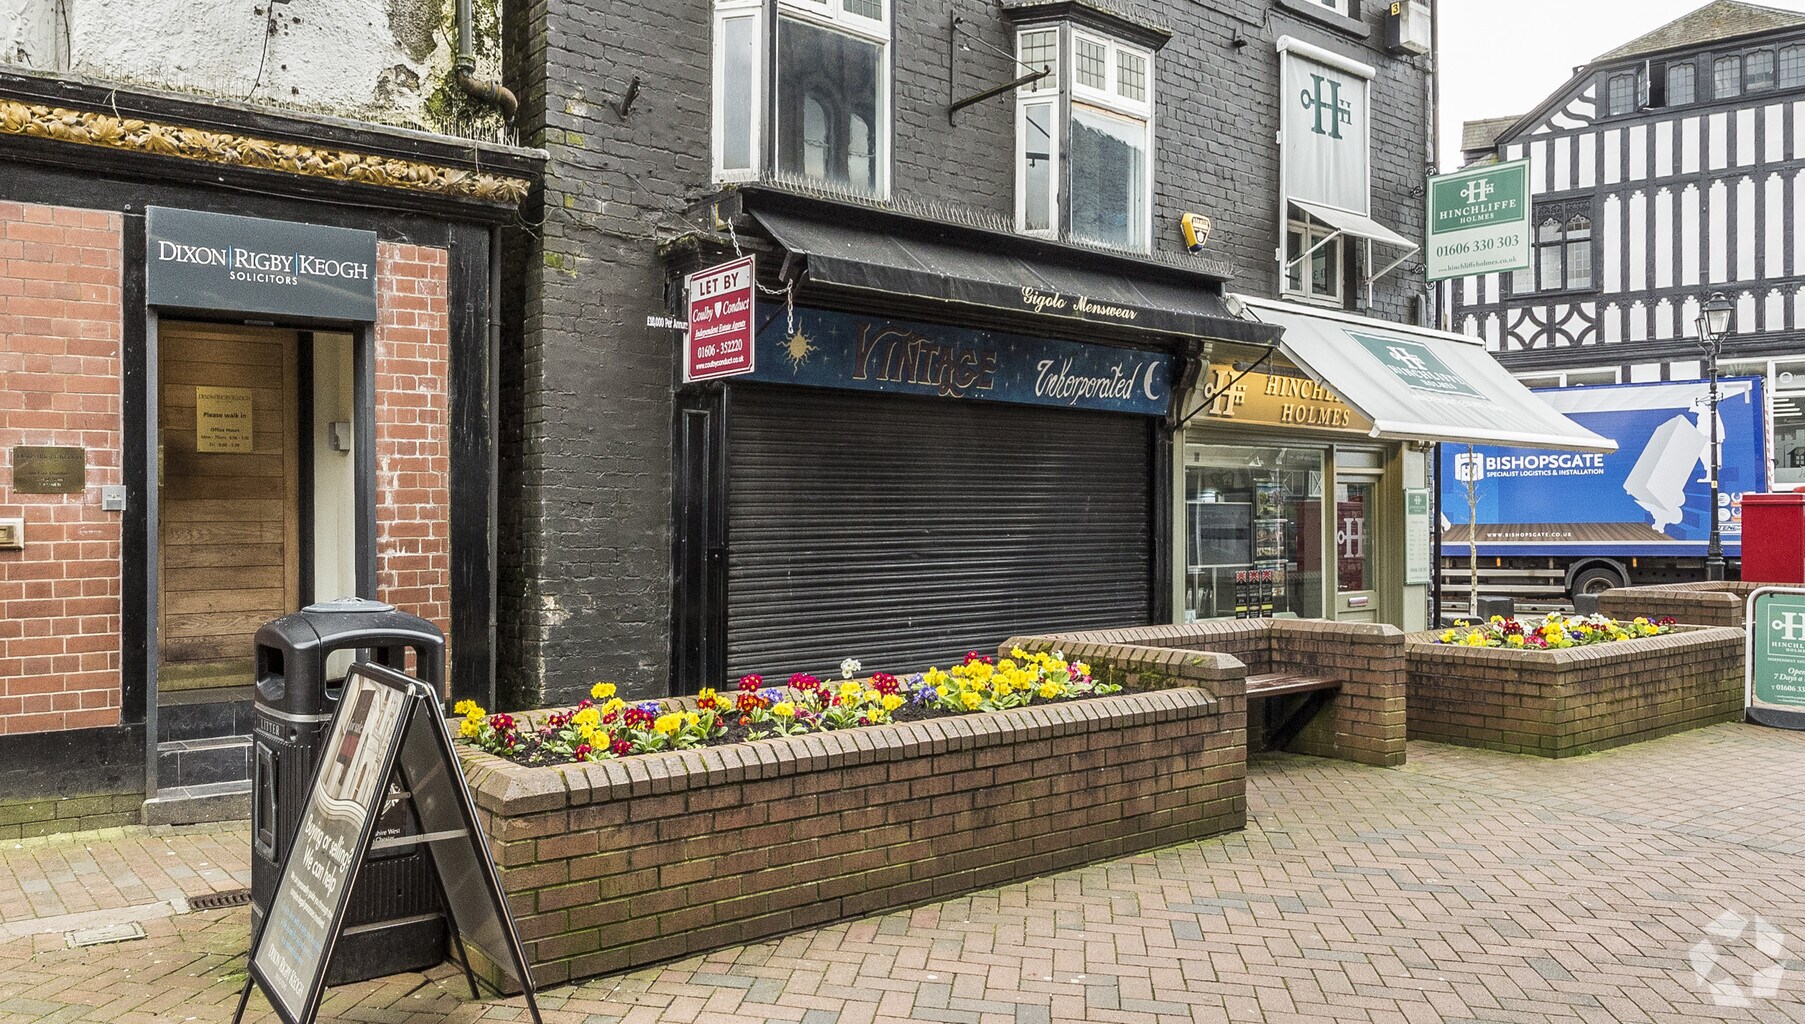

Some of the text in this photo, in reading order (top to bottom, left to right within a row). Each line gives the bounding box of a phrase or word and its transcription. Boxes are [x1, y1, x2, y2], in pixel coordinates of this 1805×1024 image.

[1393, 4, 1398, 13] 3
[1439, 198, 1517, 220] HINCHLIFFE
[1459, 213, 1495, 224] HOLMES
[1436, 234, 1519, 257] 01606 330 303
[158, 240, 369, 280] DIXON RIGBY KEOGH
[230, 270, 298, 285] SOLICITORS
[700, 272, 739, 296] LET BY
[692, 297, 750, 323] Coulby Conduct
[1021, 286, 1138, 320] Gigolo Menswear
[695, 326, 719, 338] Independent
[732, 320, 747, 330] Agents
[697, 344, 716, 359] 01606
[720, 338, 743, 355] 352220
[851, 323, 997, 397] VINTAGE
[1281, 402, 1351, 427] HOLMES
[1486, 453, 1604, 470] BISHOPSGATE
[1486, 470, 1519, 478] SPECIALIST
[1520, 469, 1551, 477] LOGISTICS
[1558, 468, 1604, 476] INSTALLATION
[1776, 684, 1796, 692] 01606
[1779, 673, 1797, 683] Days
[260, 718, 280, 737] LITTER
[305, 813, 355, 874] Buying or selling?
[303, 844, 337, 898] We can help
